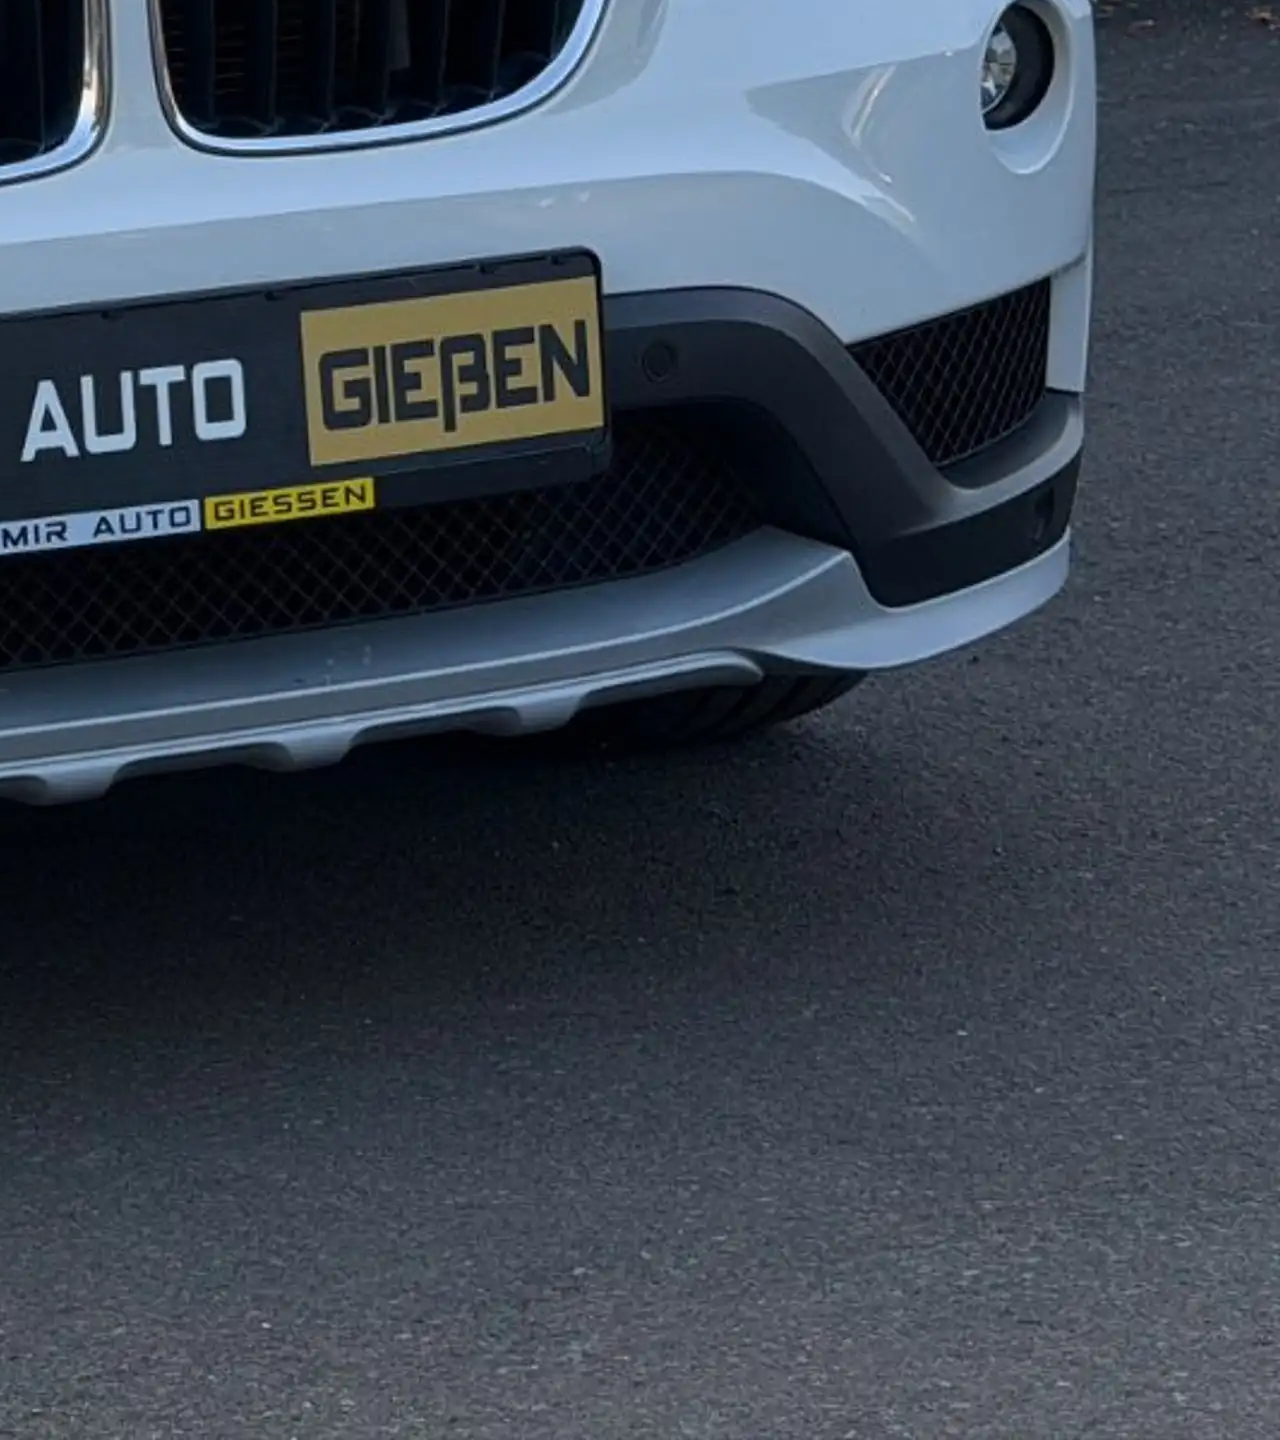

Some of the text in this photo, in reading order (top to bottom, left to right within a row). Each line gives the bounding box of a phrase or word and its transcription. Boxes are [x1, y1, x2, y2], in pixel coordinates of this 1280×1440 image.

[20, 358, 247, 464] AUTO
[318, 319, 592, 433] GIEßEN
[0, 482, 367, 550] MIR AUTO GIESSEN
